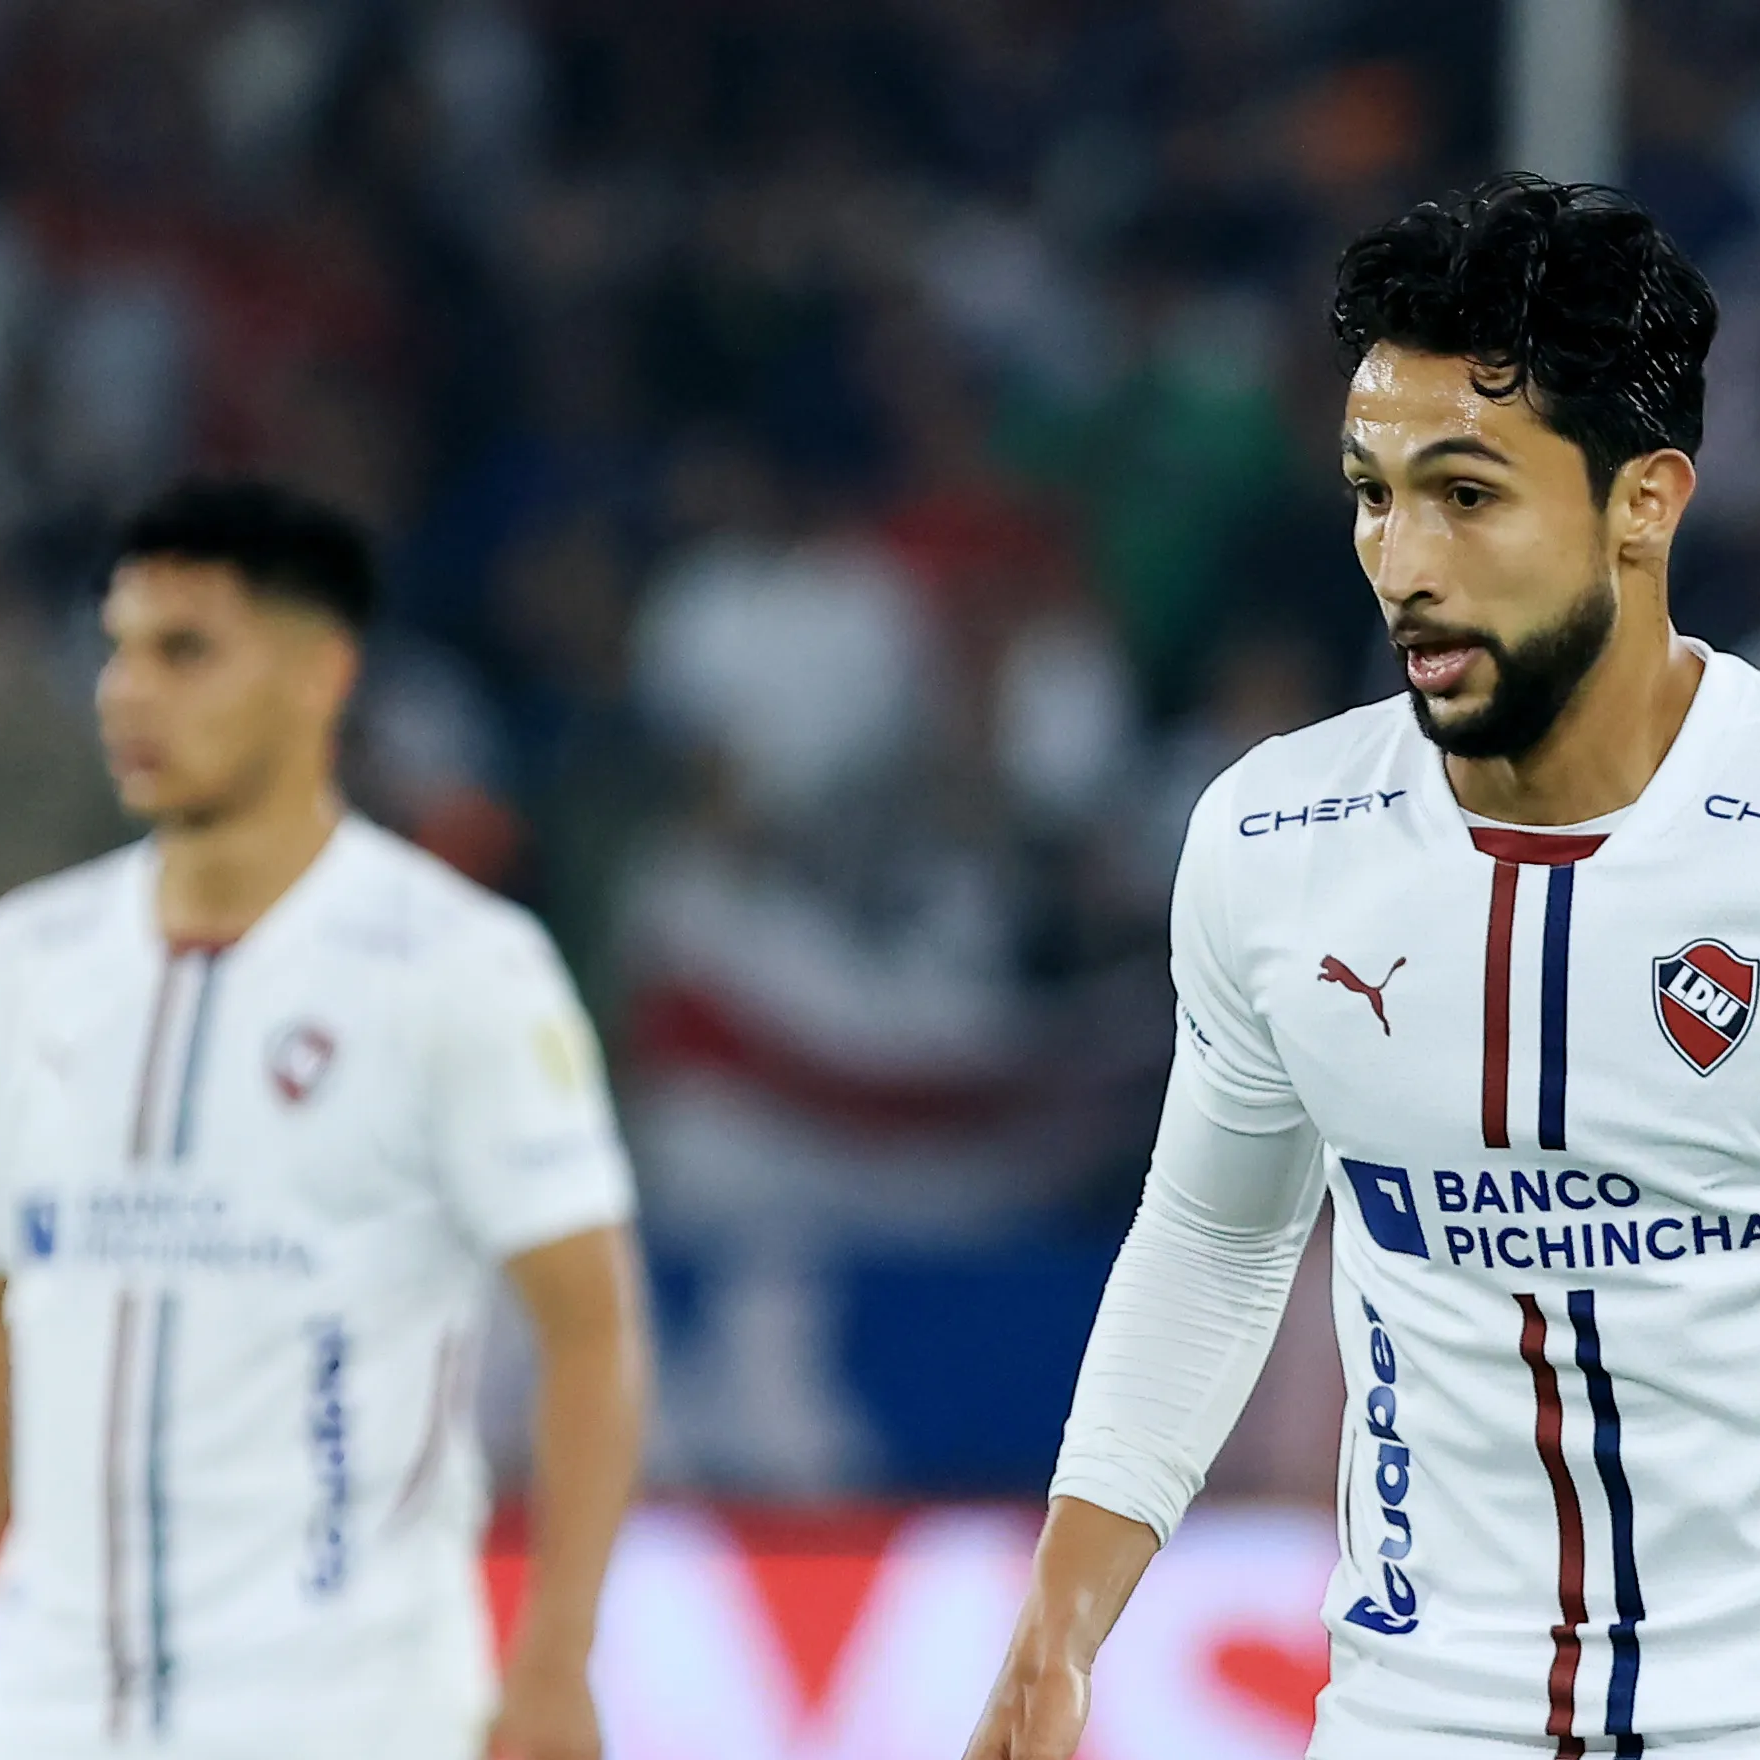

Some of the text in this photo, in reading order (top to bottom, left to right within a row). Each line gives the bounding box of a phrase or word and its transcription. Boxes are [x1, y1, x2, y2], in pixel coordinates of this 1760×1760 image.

[1239, 789, 1407, 837] CHERY
[1666, 964, 1742, 1028] LDU
[1433, 1169, 1641, 1214] BANCO
